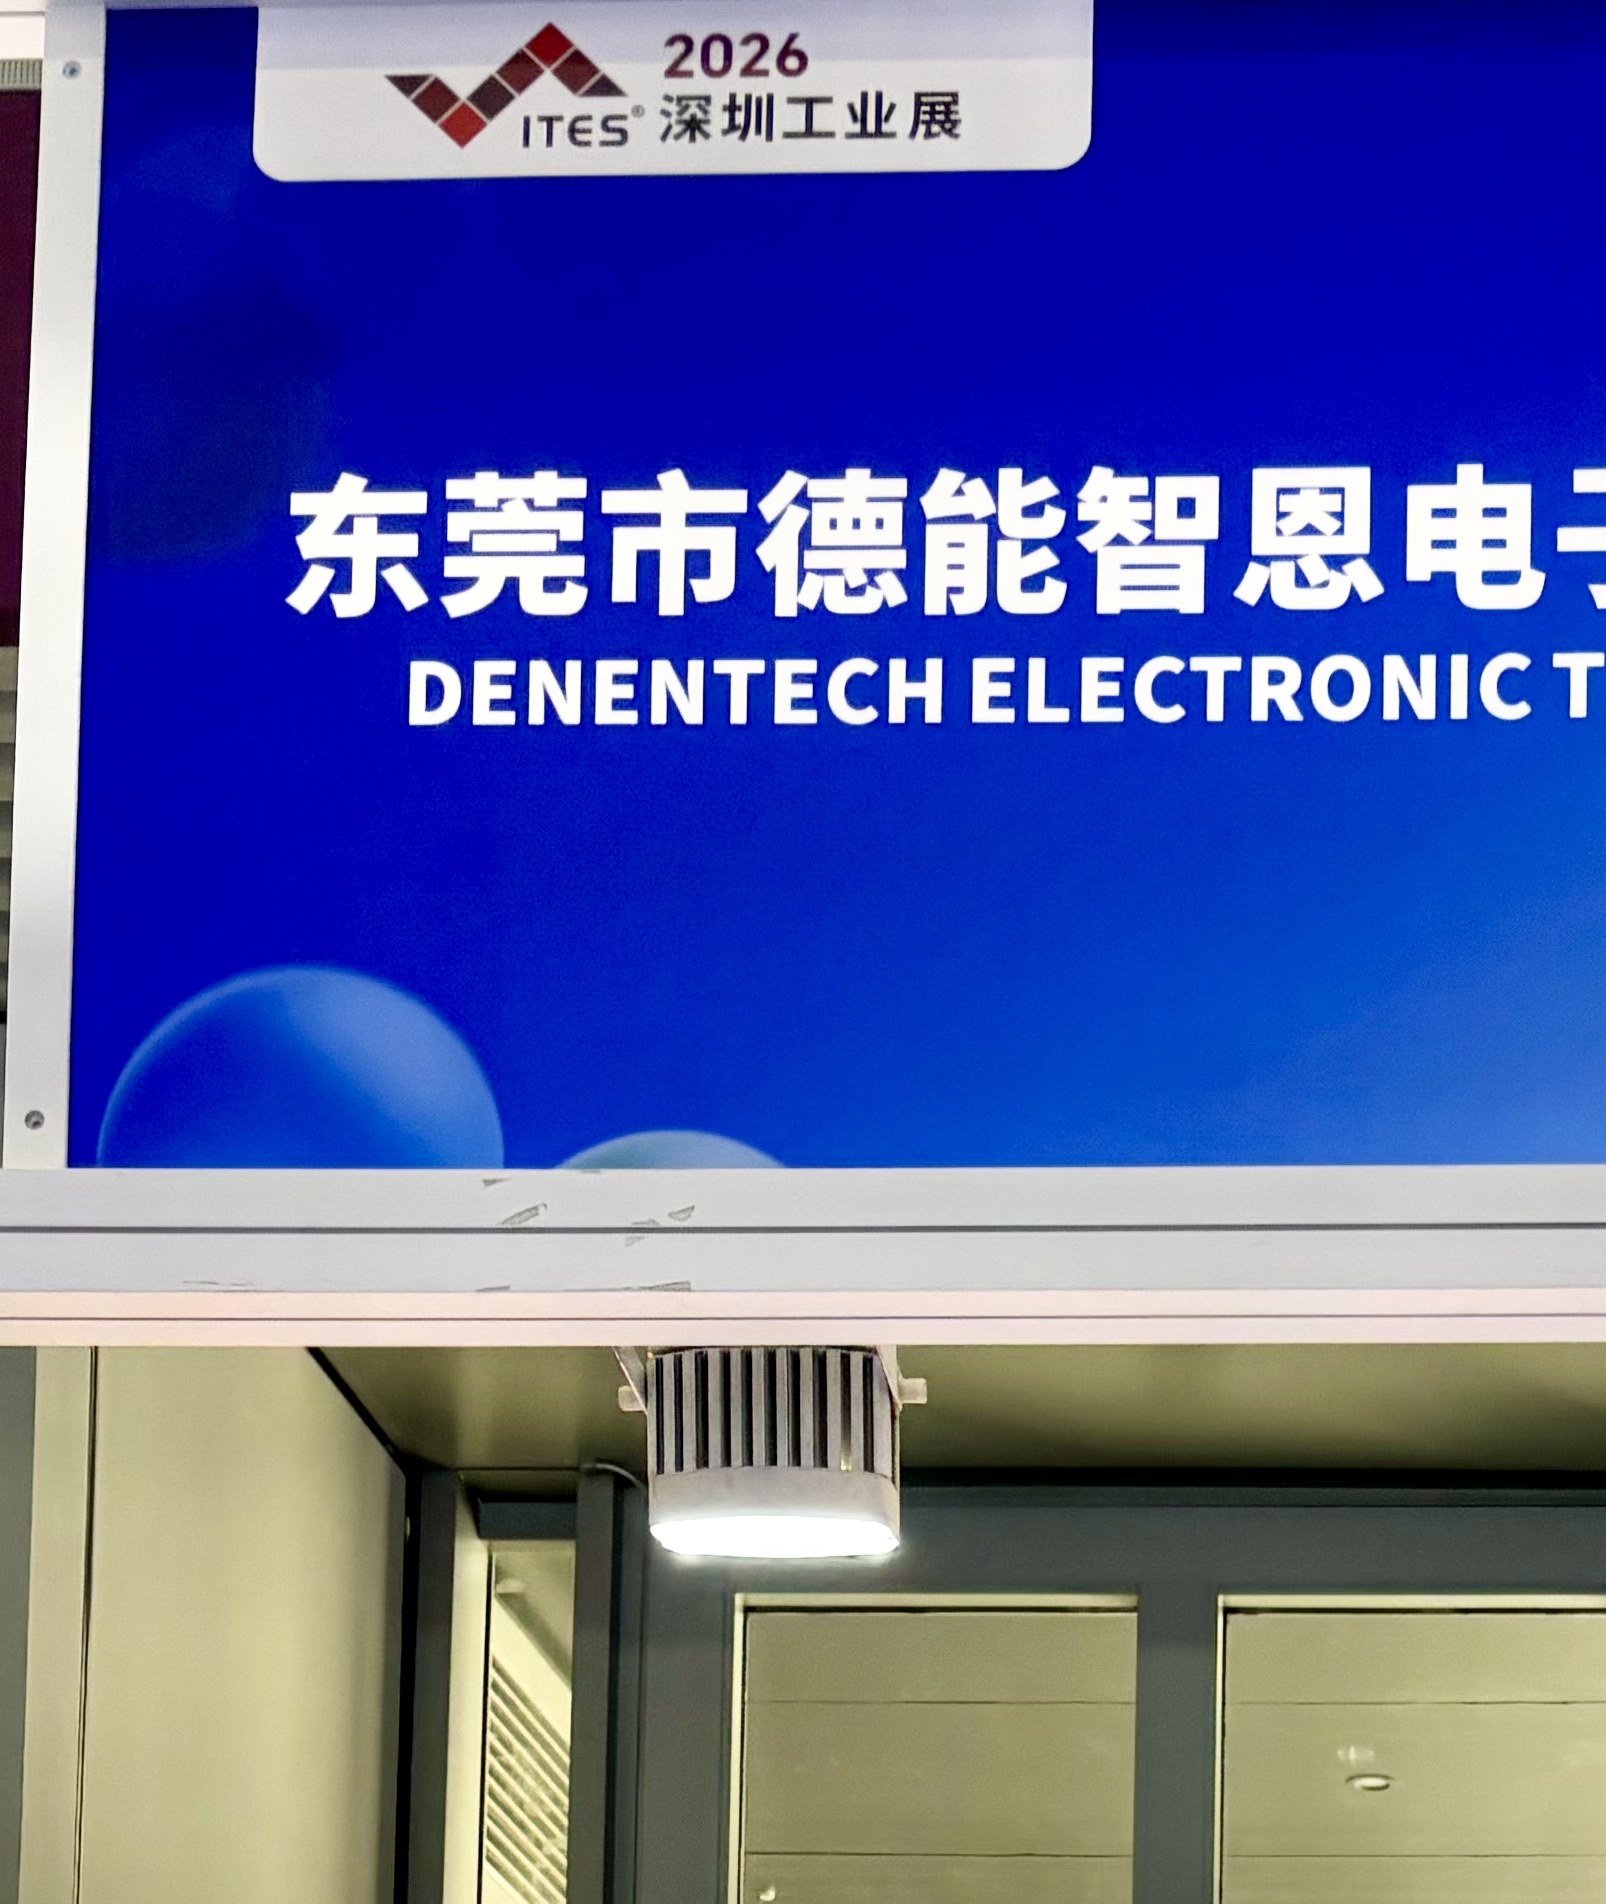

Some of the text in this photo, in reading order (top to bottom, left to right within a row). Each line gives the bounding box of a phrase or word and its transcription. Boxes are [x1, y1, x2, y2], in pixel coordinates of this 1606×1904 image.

[663, 32, 809, 79] 2026
[659, 89, 962, 143] 深圳工业展
[408, 655, 944, 728] DENENTECH
[972, 650, 1533, 726] ELECTRONIC
